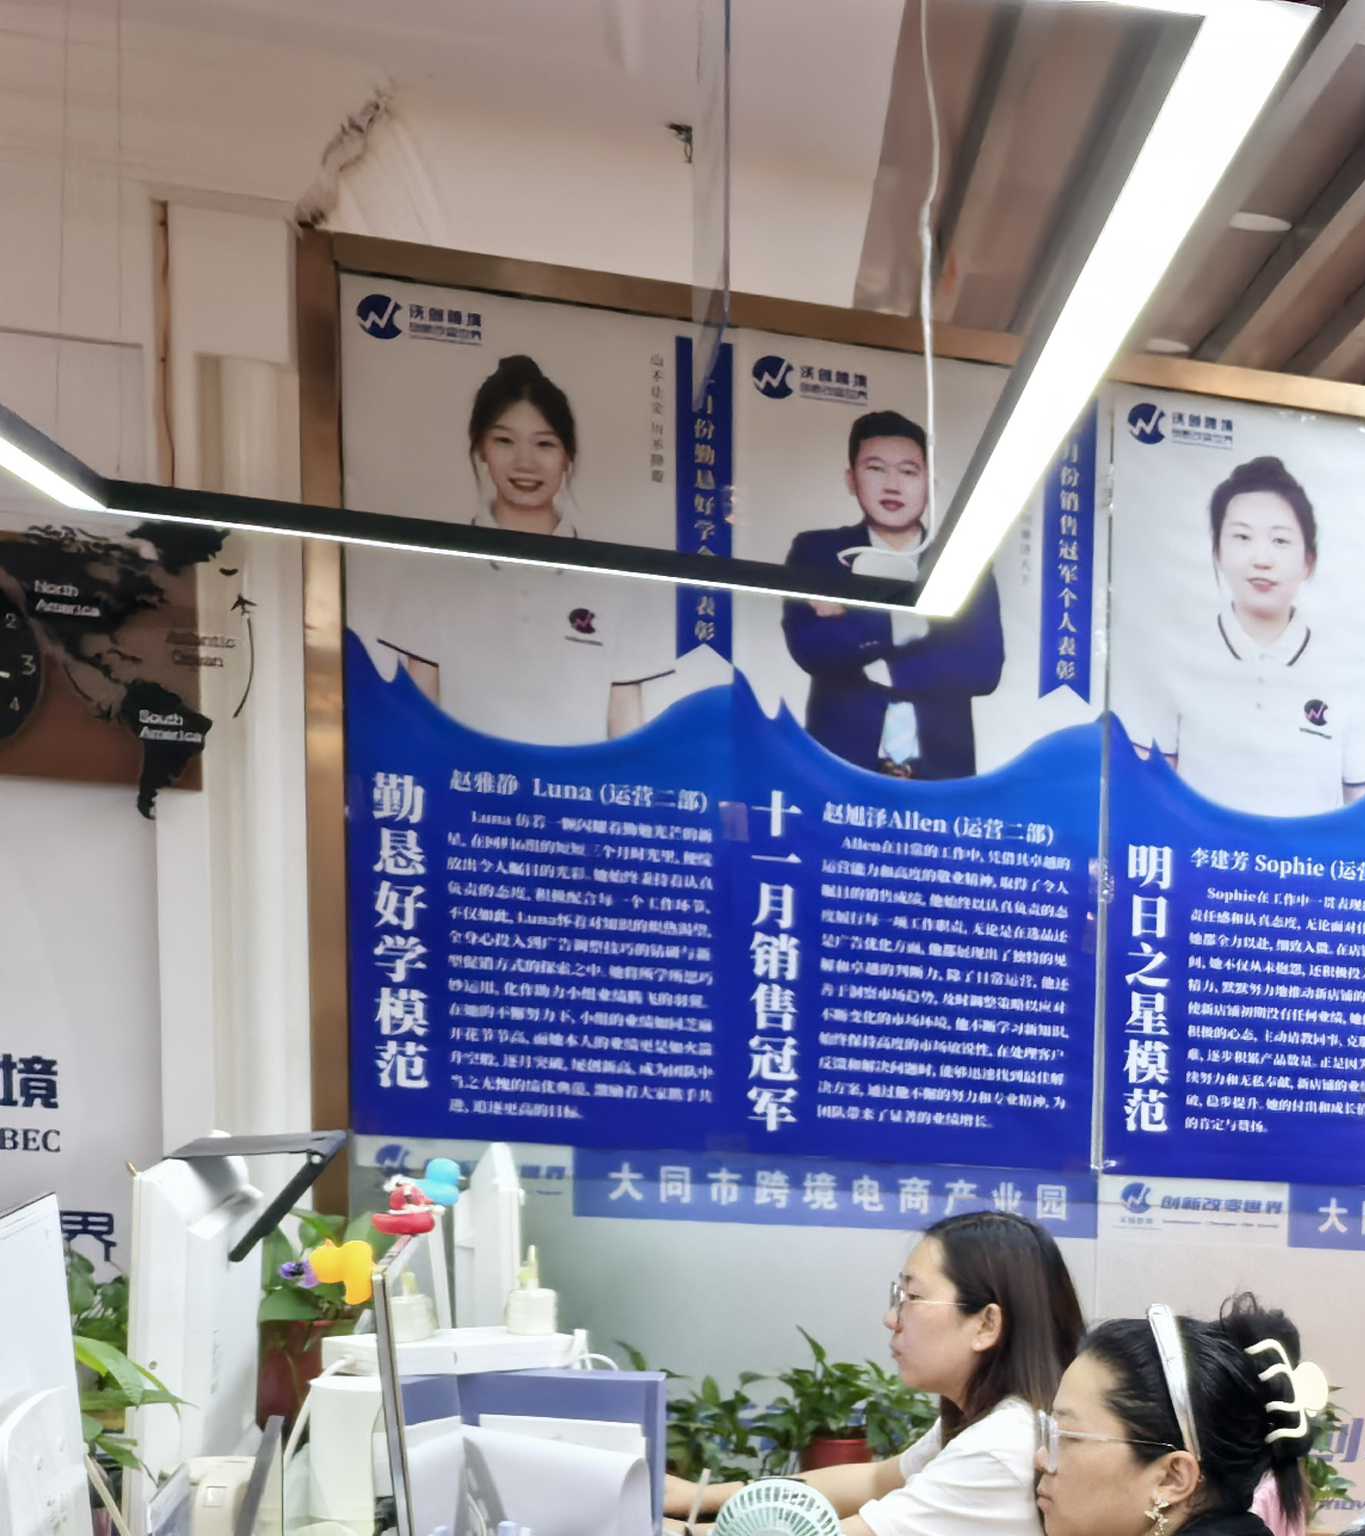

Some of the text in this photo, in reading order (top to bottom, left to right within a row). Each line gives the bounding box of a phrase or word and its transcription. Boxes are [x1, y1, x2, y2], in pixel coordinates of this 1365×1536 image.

[34, 578, 79, 598] North
[35, 598, 101, 618] America
[5, 612, 17, 629] 2
[20, 653, 37, 675] 3
[139, 708, 184, 727] South
[139, 725, 204, 744] America
[533, 777, 592, 801] Luna
[953, 815, 1056, 848] (运营二部)
[1190, 847, 1250, 873] 李建芳
[1254, 854, 1326, 880] Sophie
[371, 771, 431, 1091] 勤恳好学模范
[746, 788, 804, 1133] 十一月销售冠军
[1123, 843, 1174, 1134] 明日之星模范
[607, 1165, 1070, 1223] 大同市跨境电商产业园
